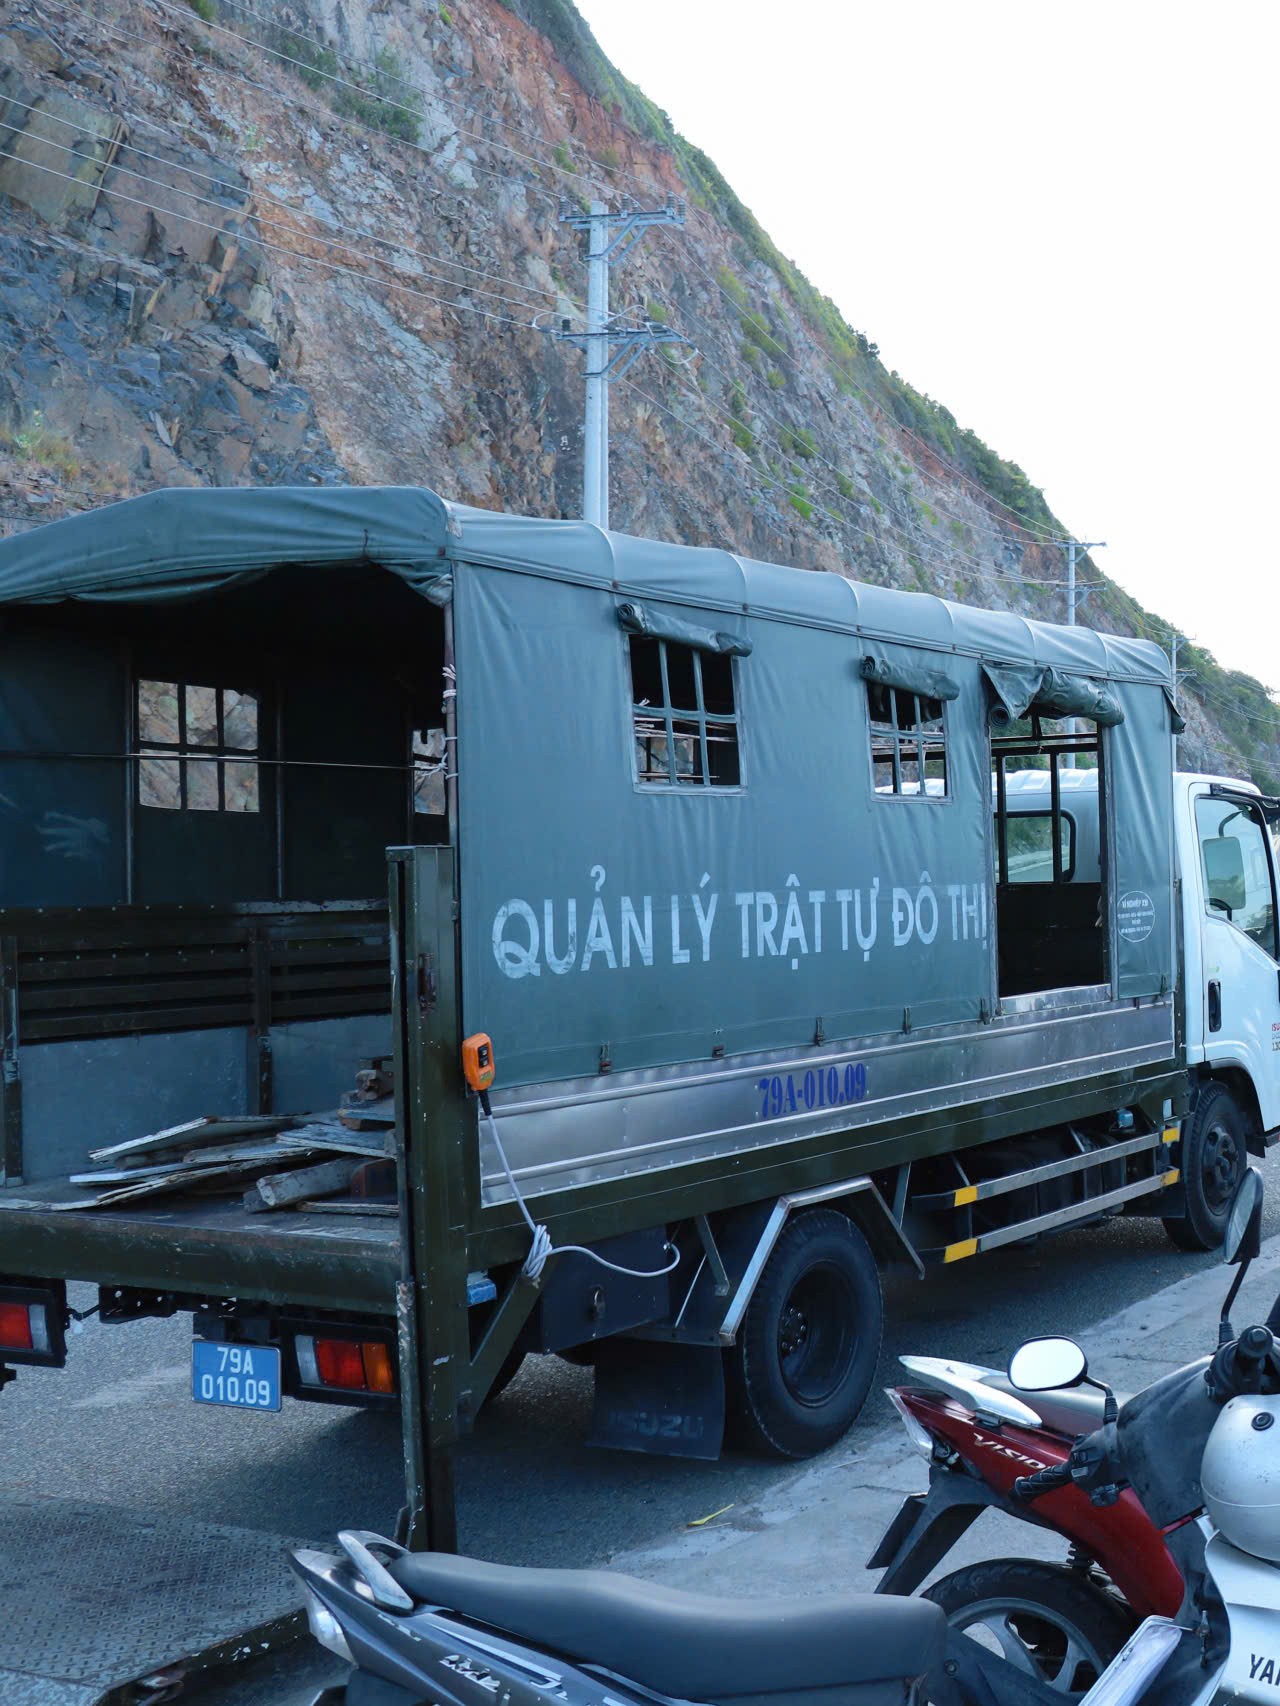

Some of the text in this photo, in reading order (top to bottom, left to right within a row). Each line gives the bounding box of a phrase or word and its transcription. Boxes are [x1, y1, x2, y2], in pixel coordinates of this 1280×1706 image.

[492, 865, 987, 979] QUẢN LÝ TRẬT TỰ ĐÔ THỊ
[759, 1063, 867, 1118] 79A-010.09
[217, 1346, 254, 1375] 79A
[201, 1373, 270, 1406] 010.09
[973, 1432, 1047, 1470] VISIO
